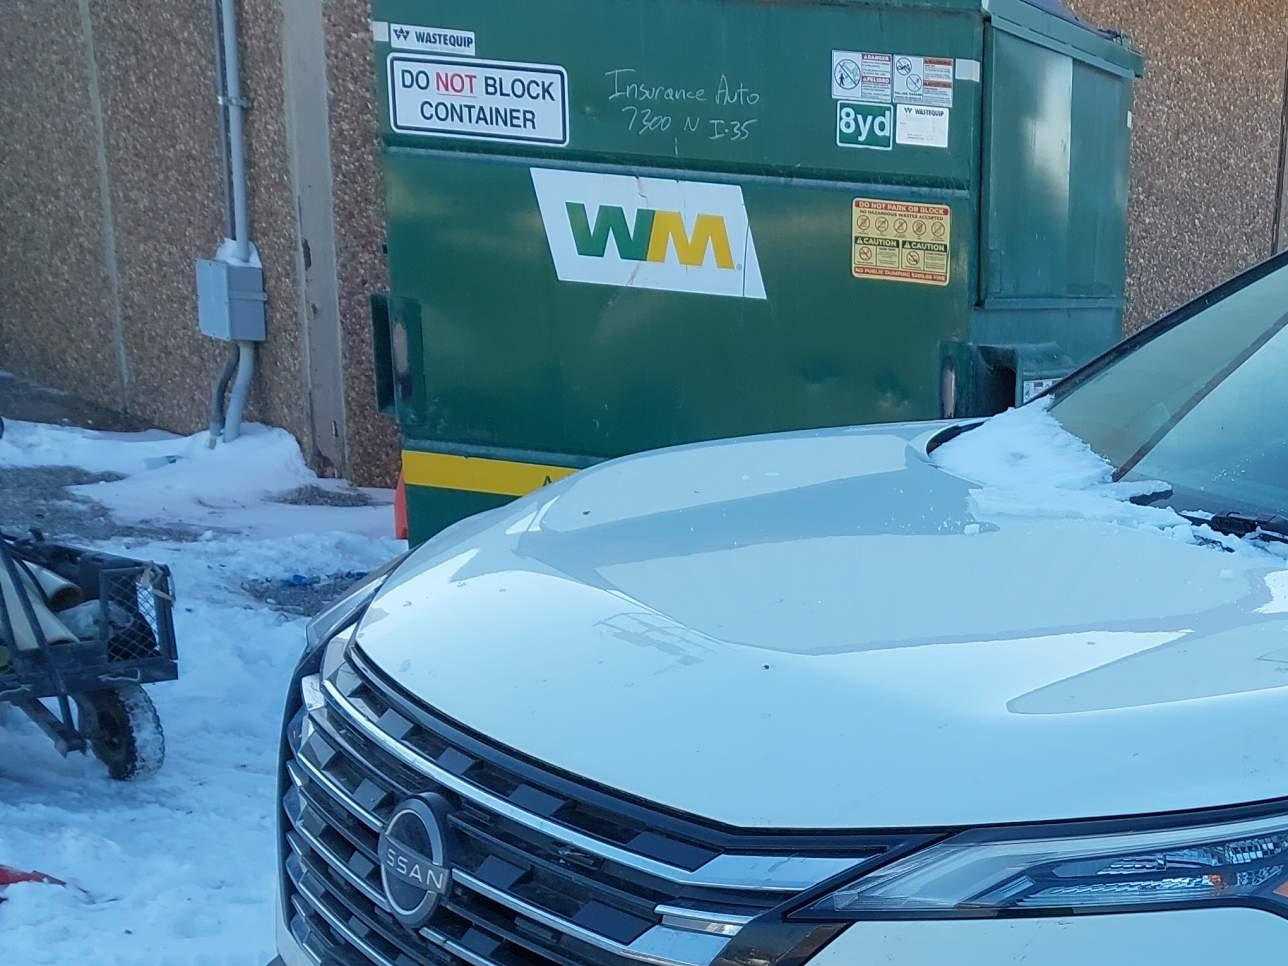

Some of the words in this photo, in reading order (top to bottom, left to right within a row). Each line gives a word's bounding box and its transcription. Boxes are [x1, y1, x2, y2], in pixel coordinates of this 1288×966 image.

[415, 31, 473, 48] WASTEQUIP
[401, 69, 430, 90] DO
[436, 71, 477, 94] NOT
[485, 76, 555, 101] BLOCK
[605, 69, 706, 101] Insurance
[715, 74, 760, 104] Auto
[421, 101, 536, 129] CONTAINER
[621, 106, 672, 135] 7300
[684, 117, 700, 132] N
[840, 107, 891, 141] 8yd
[915, 108, 944, 118] WASTEQUIP
[887, 203, 906, 211] PARK
[920, 206, 945, 214] BLOCK
[565, 201, 735, 270] WM
[863, 237, 897, 247] CAUTION
[911, 241, 945, 251] CAUTION
[386, 848, 443, 889] SSAN
